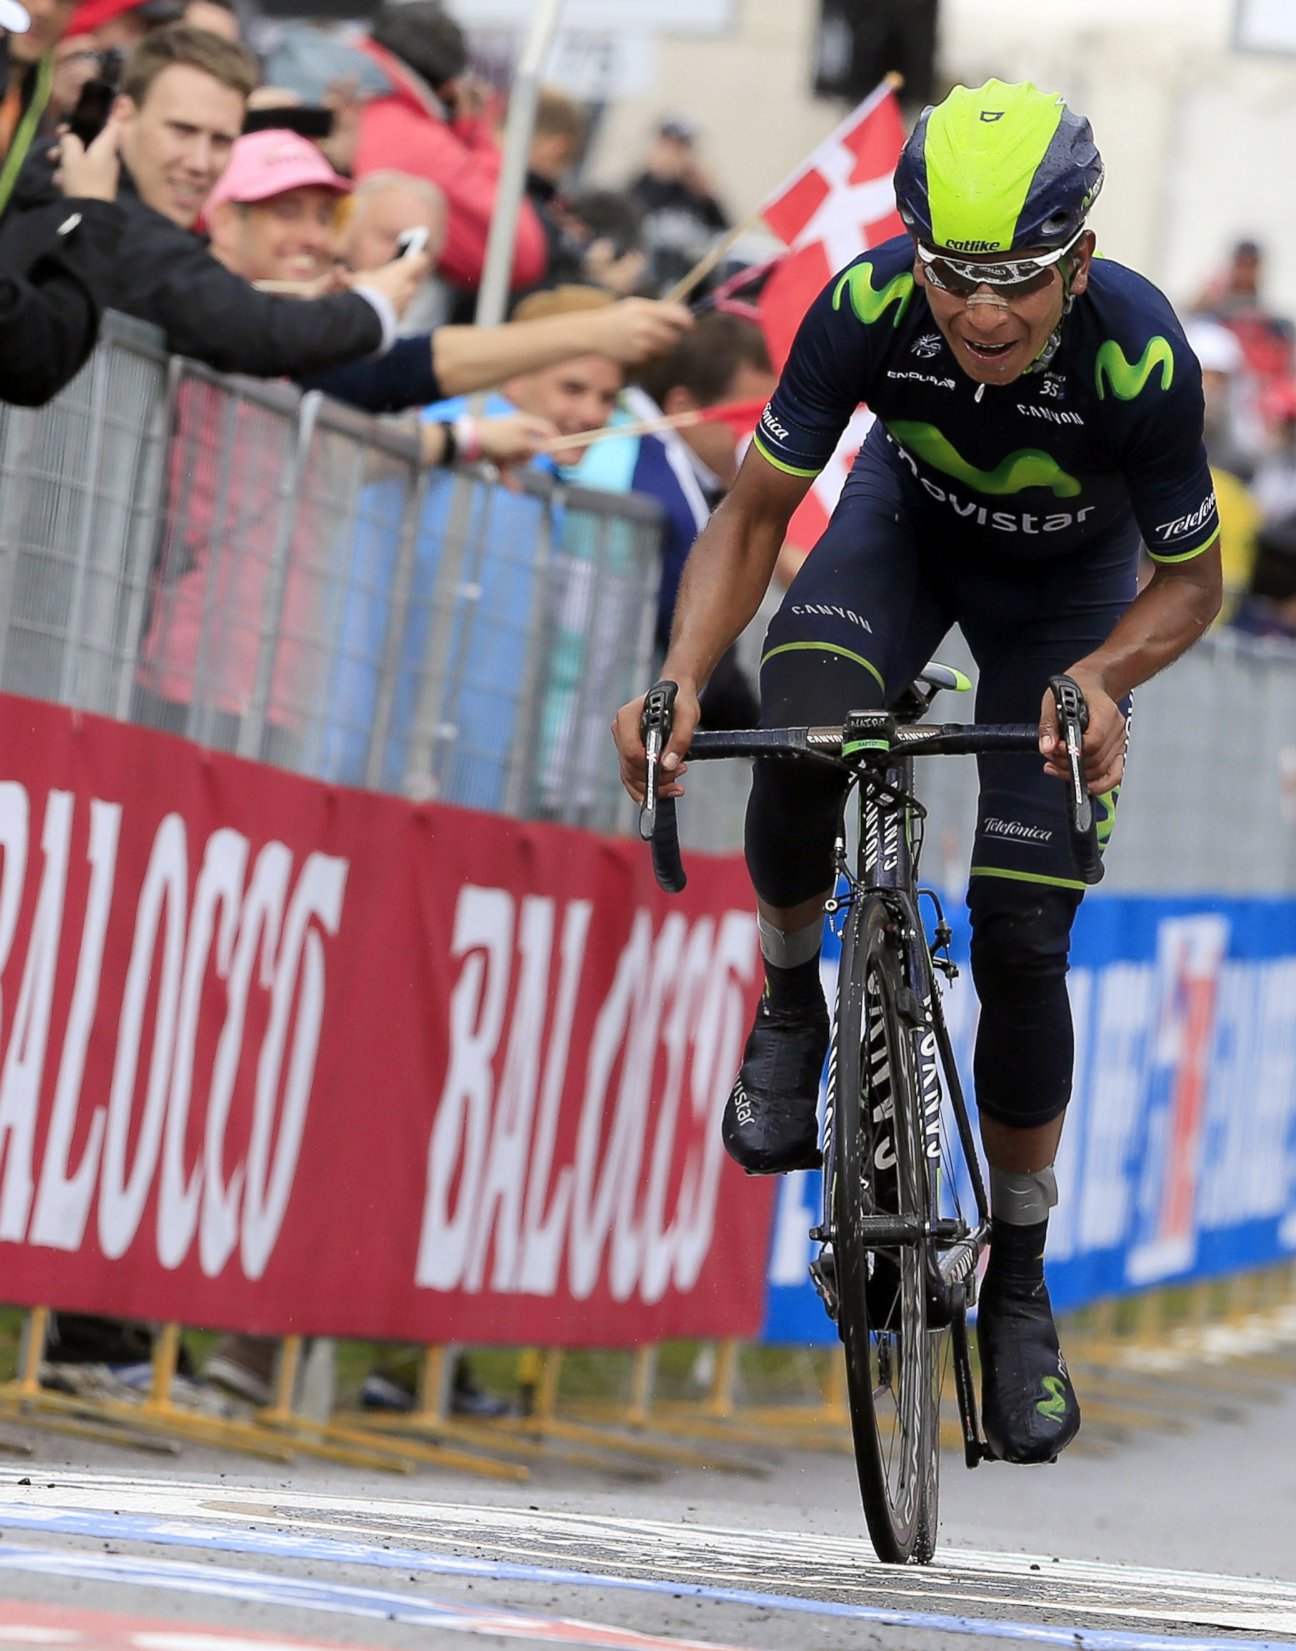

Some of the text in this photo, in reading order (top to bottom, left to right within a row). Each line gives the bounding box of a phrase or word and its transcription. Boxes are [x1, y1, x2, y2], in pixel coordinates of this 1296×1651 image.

[945, 239, 1000, 251] catlike
[1039, 380, 1060, 398] 35
[1016, 403, 1085, 425] CANYON
[791, 604, 873, 634] CANYON
[883, 781, 898, 871] CANY
[984, 817, 1053, 841] Telefónica
[414, 883, 758, 1306] BALOCCO
